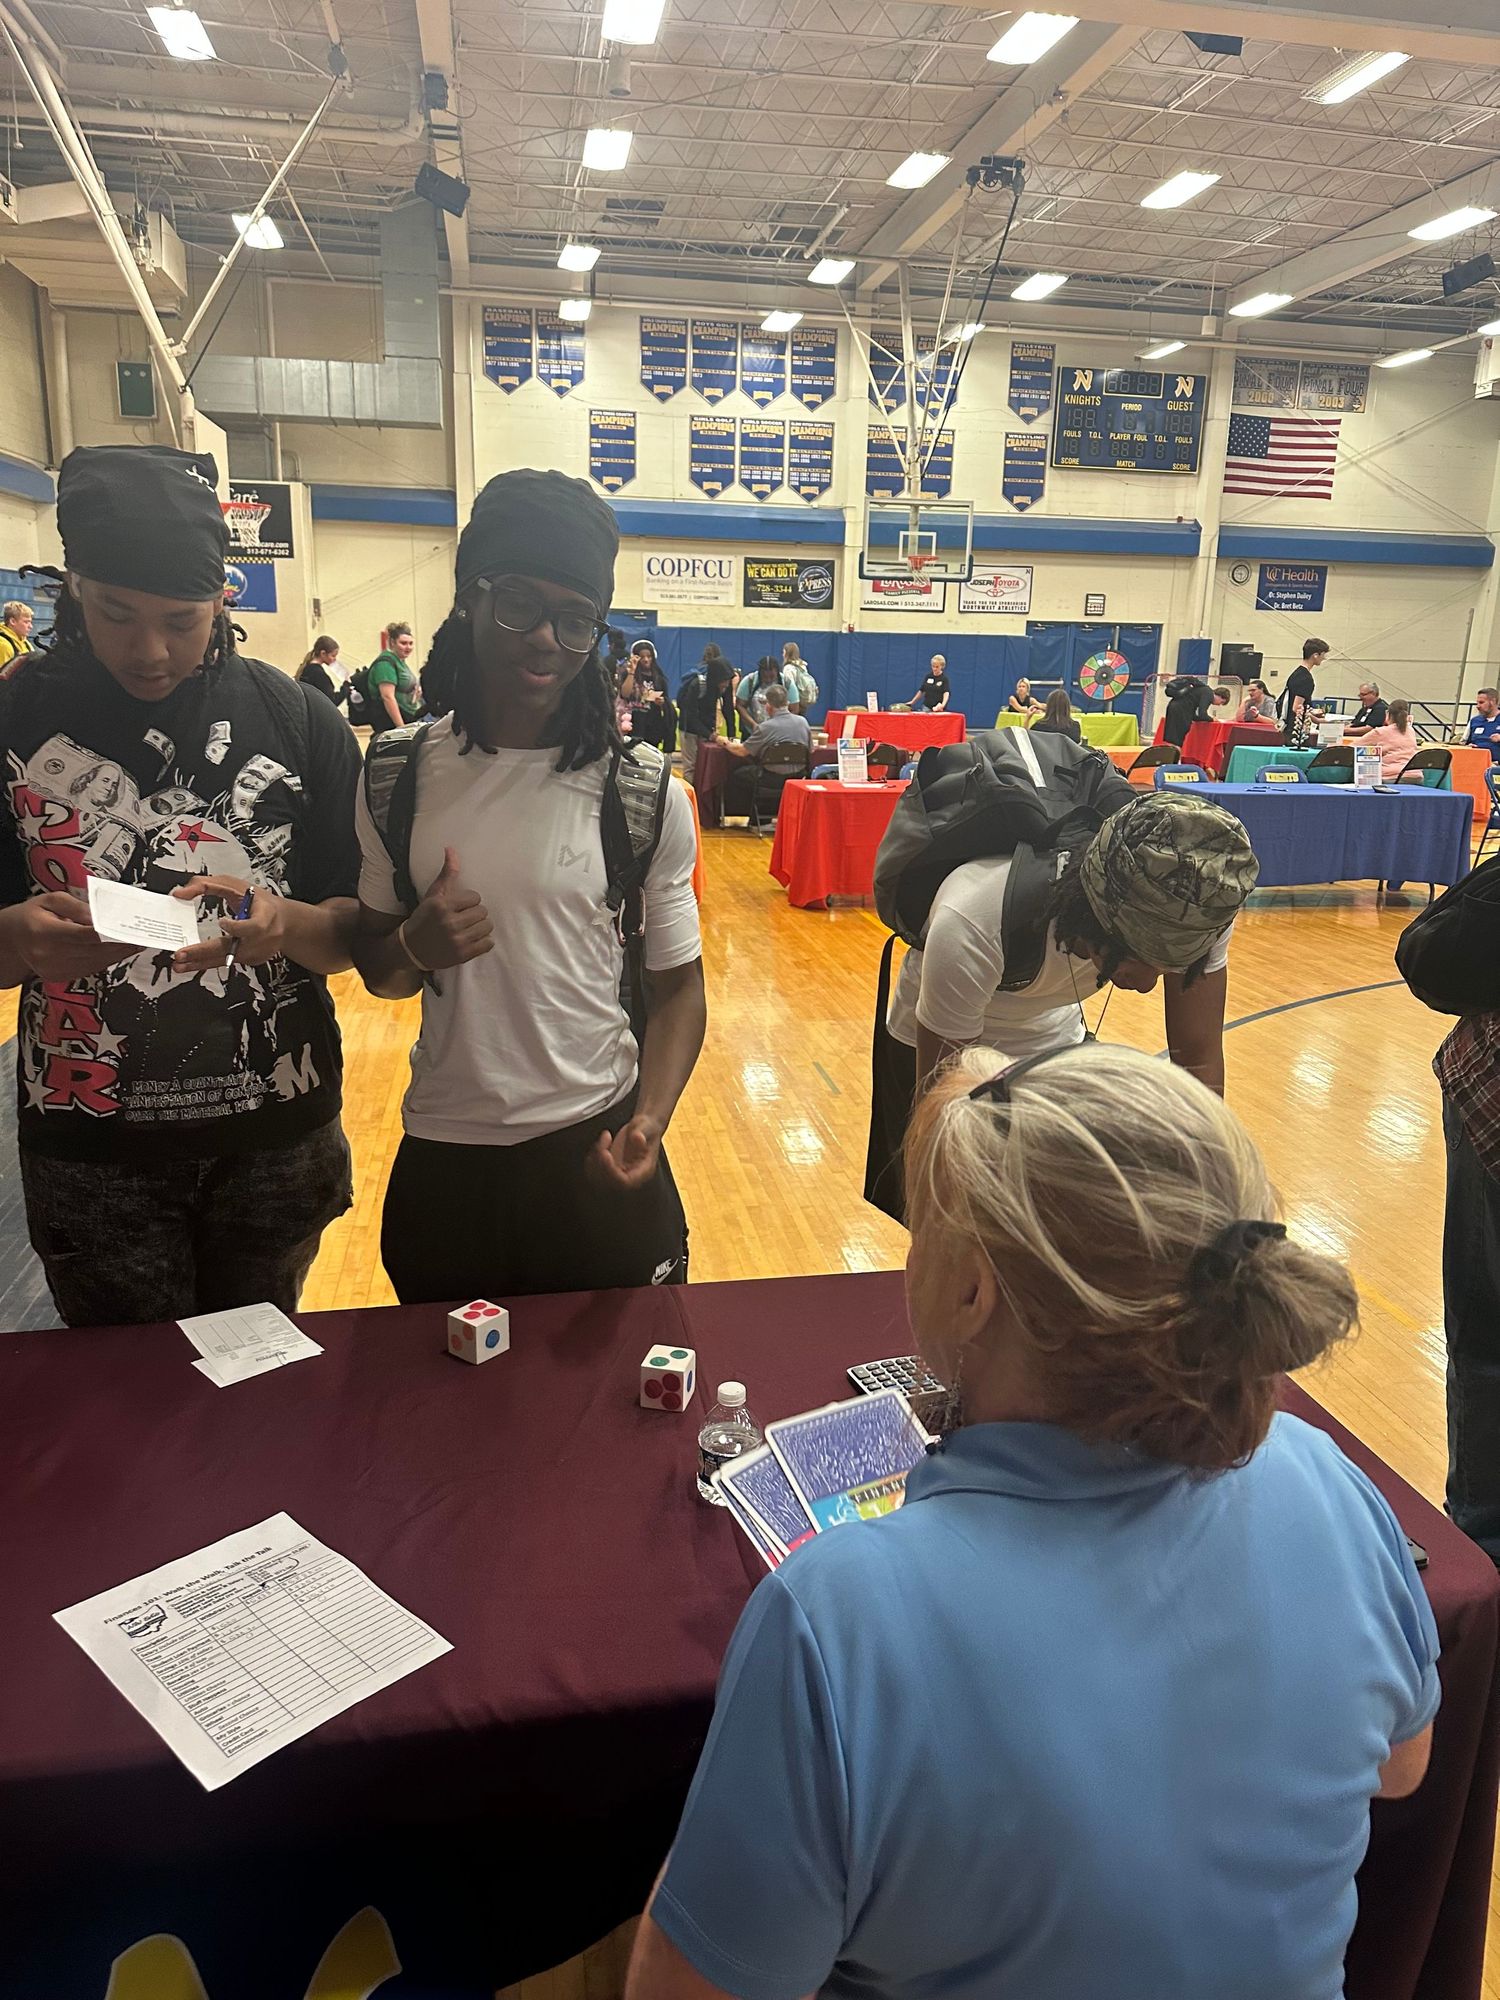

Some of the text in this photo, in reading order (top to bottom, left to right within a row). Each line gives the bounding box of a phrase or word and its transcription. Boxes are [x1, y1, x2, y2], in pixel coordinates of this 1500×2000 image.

[485, 313, 530, 324] CHAMPIONS
[642, 322, 685, 334] CHAMPIONS
[694, 326, 736, 337] CHAMPIONS
[793, 333, 835, 344] CHAMPIONS
[1013, 348, 1053, 359] CHAMPIONS
[1337, 378, 1365, 396] FOUR
[1064, 394, 1101, 406] KNIGHTS
[1248, 390, 1274, 404] 2000
[1319, 395, 1345, 408] 2003
[1121, 403, 1142, 411] PERIOD
[1167, 401, 1195, 411] GUEST
[591, 416, 634, 427] CHAMPIONS
[692, 421, 734, 432] CHAMPIONS
[742, 424, 784, 435] CHAMPIONS
[791, 427, 832, 437] CHAMPIONS
[868, 432, 906, 441] CHAMPNS
[1175, 436, 1193, 444] FOULS
[1007, 438, 1046, 449] CHAMPIONS
[1061, 457, 1079, 465] SCORE
[1116, 460, 1136, 468] MATCH
[647, 557, 733, 579] COPFCU
[747, 568, 759, 578] WE
[760, 568, 776, 578] CAN
[778, 568, 787, 578] DO
[1282, 568, 1318, 581] Health
[798, 577, 832, 592] EXPRESS
[970, 576, 1020, 588] JOSEPH TOYOTA
[183, 1070, 256, 1090] QUANTITATIE
[103, 1605, 143, 1625] Finances
[143, 1595, 161, 1606] 101:
[164, 1585, 185, 1597] Walk
[185, 1579, 201, 1588] the
[202, 1569, 225, 1581] Walk,
[224, 1561, 242, 1571] Talk
[242, 1555, 256, 1564] the
[256, 1546, 272, 1556] Talk
[221, 1728, 254, 1746] Credit Card
[227, 1729, 269, 1752] Entertainment
